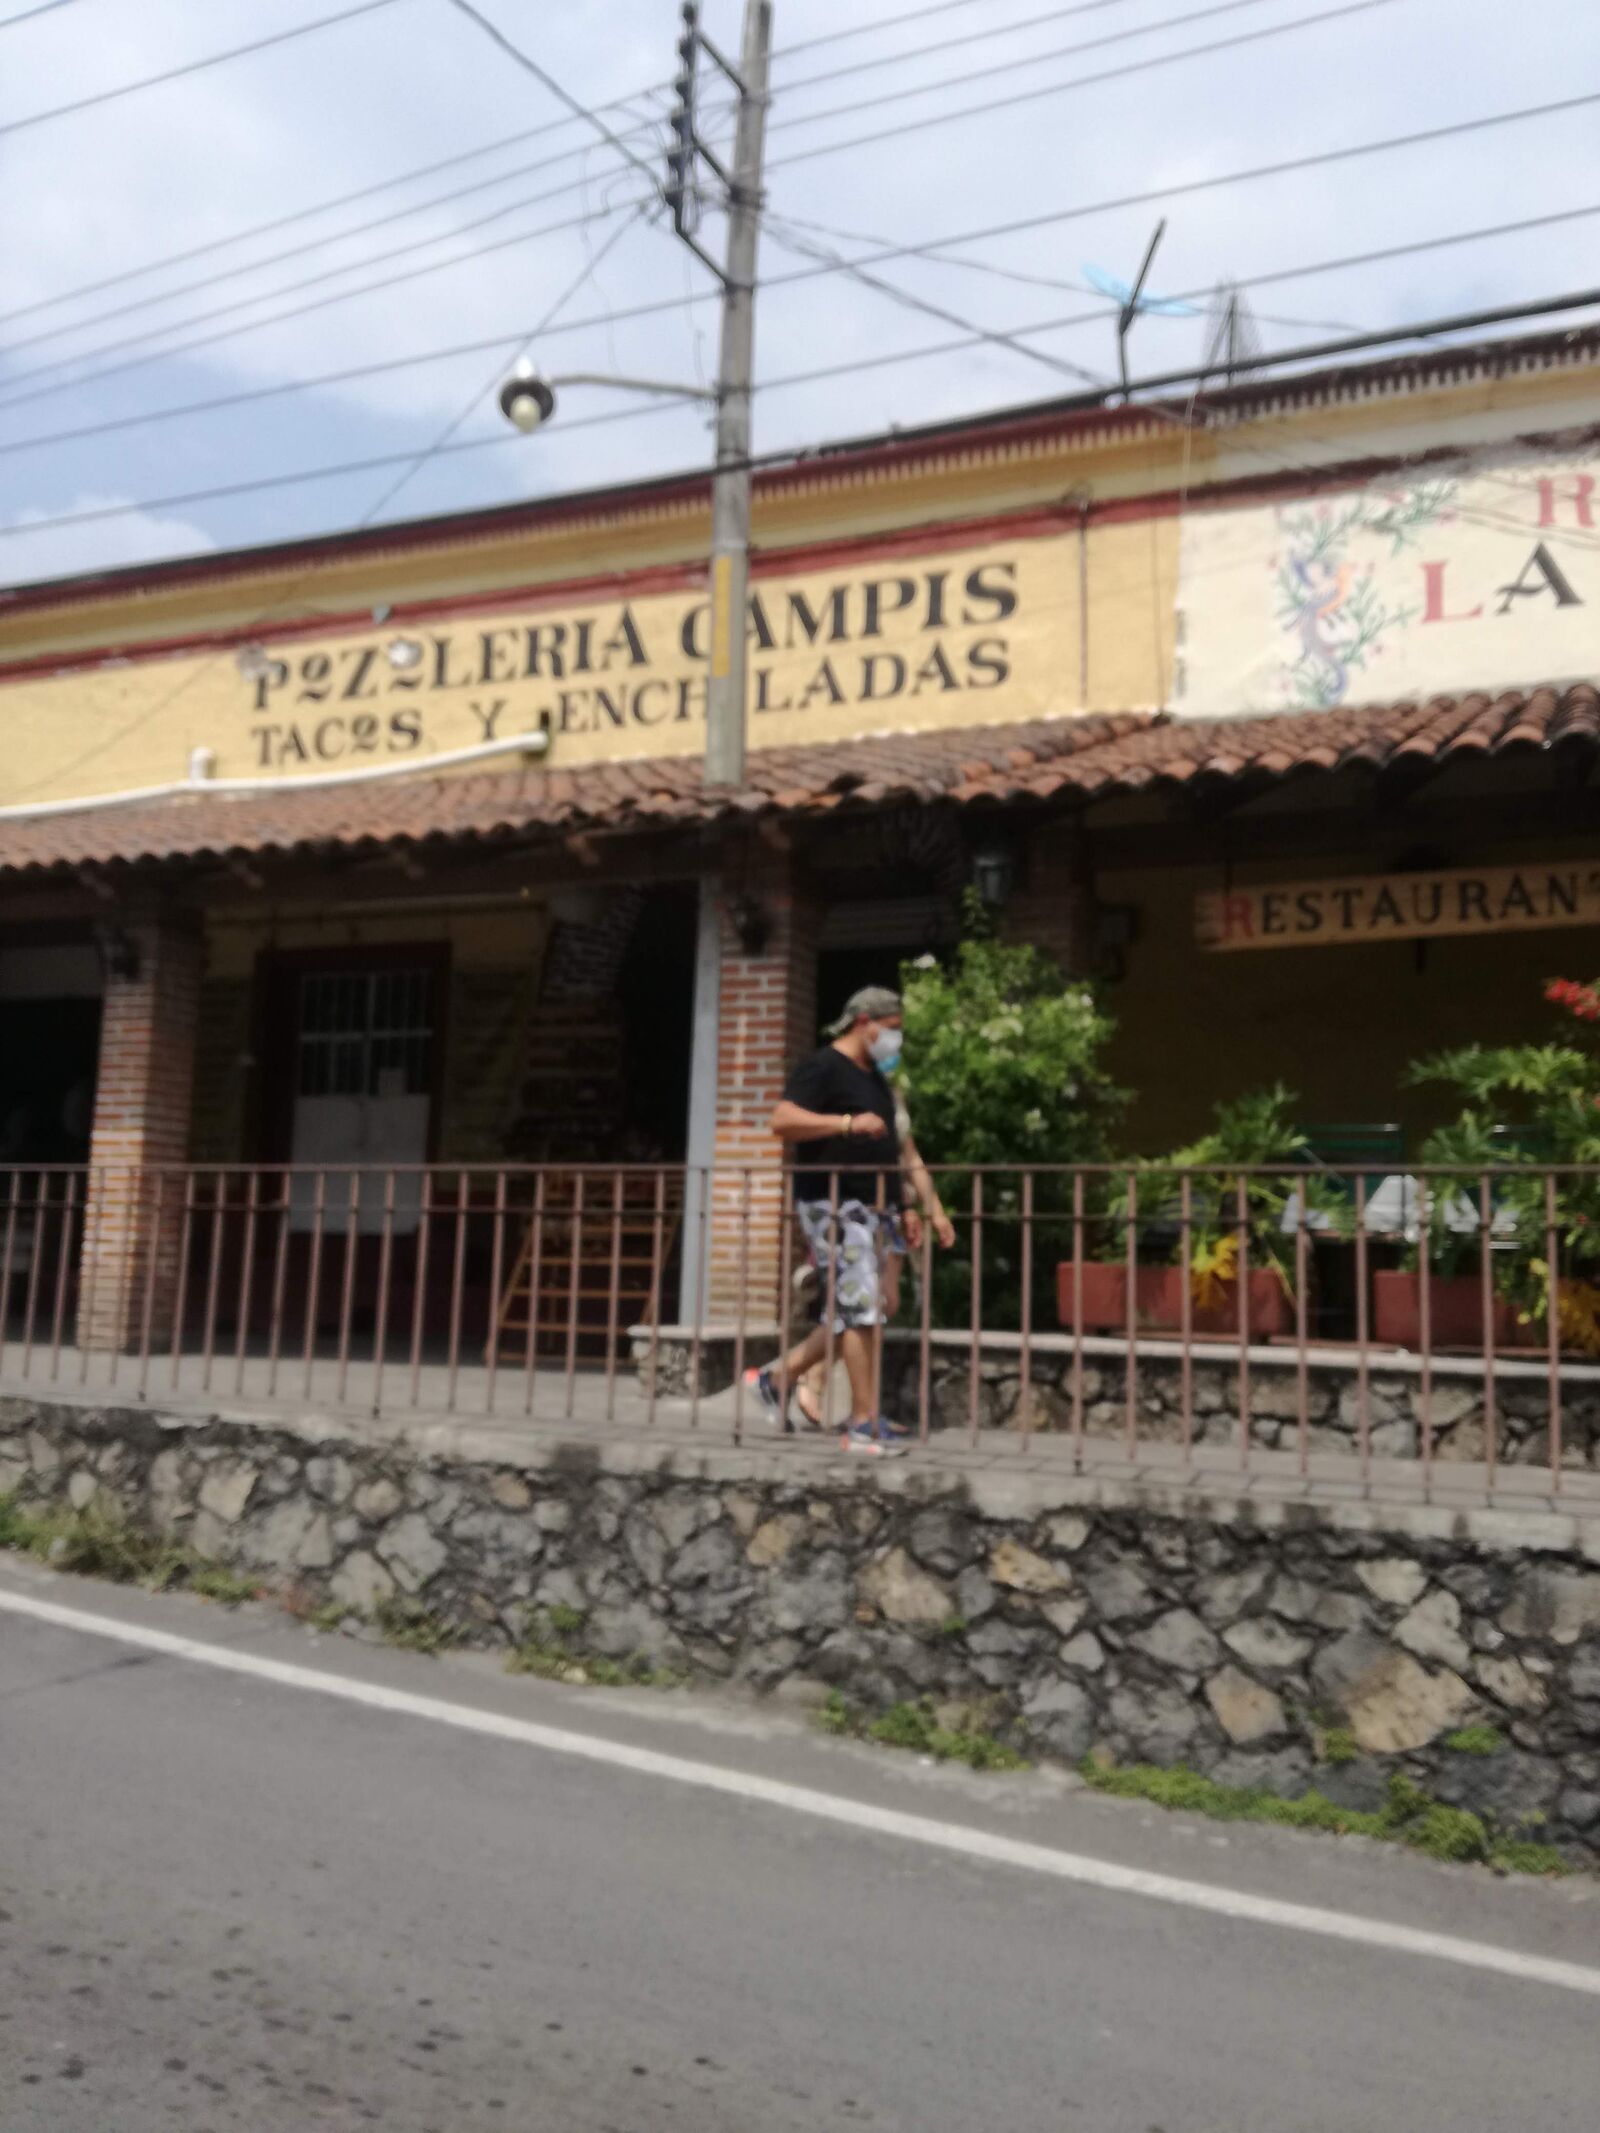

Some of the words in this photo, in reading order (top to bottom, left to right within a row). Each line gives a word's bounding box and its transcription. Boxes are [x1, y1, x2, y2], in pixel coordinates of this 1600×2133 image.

[1537, 474, 1596, 528] R
[681, 561, 1018, 661] CAMPIS
[1421, 541, 1585, 624] LA
[252, 710, 422, 767] TACOS
[471, 698, 511, 742] Y
[557, 638, 1010, 734] ENCHLADAS
[1221, 870, 1600, 941] RESTAURAN
